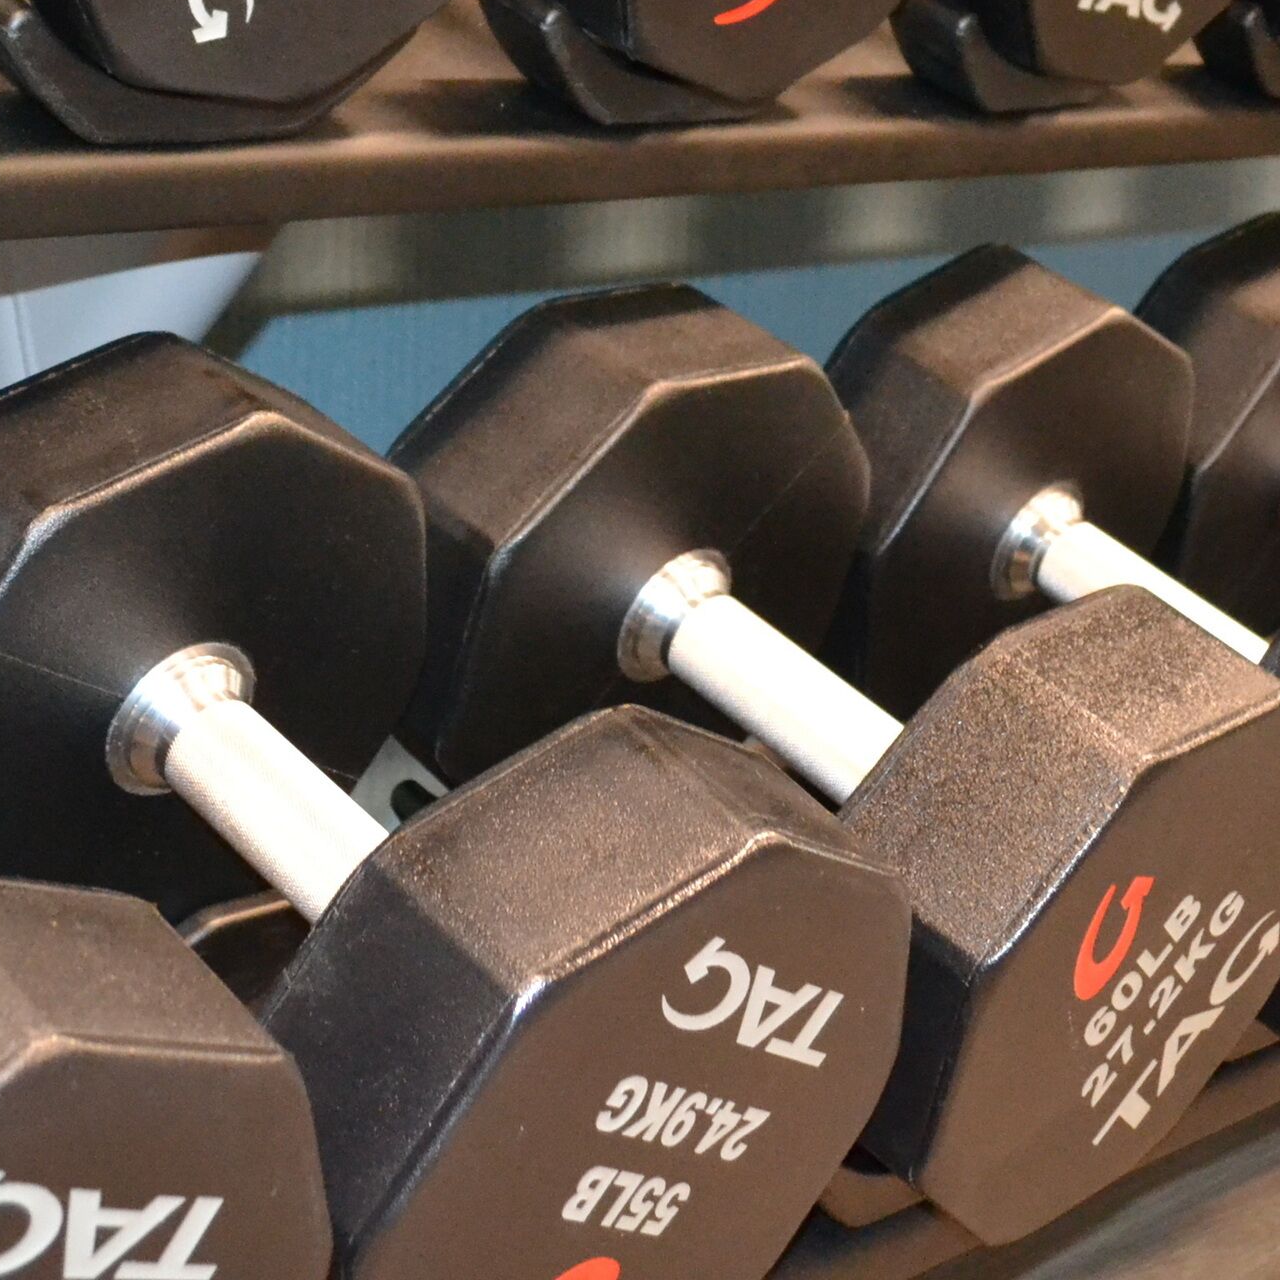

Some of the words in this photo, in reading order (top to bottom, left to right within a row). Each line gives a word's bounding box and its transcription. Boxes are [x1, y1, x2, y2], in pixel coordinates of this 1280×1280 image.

[661, 935, 845, 1068] TAG
[1081, 890, 1246, 1108] 27.2KG
[1083, 894, 1202, 1047] 60LB
[1091, 909, 1280, 1146] TAG
[595, 1074, 771, 1162] 24.9KG
[561, 1165, 691, 1237] 55LB
